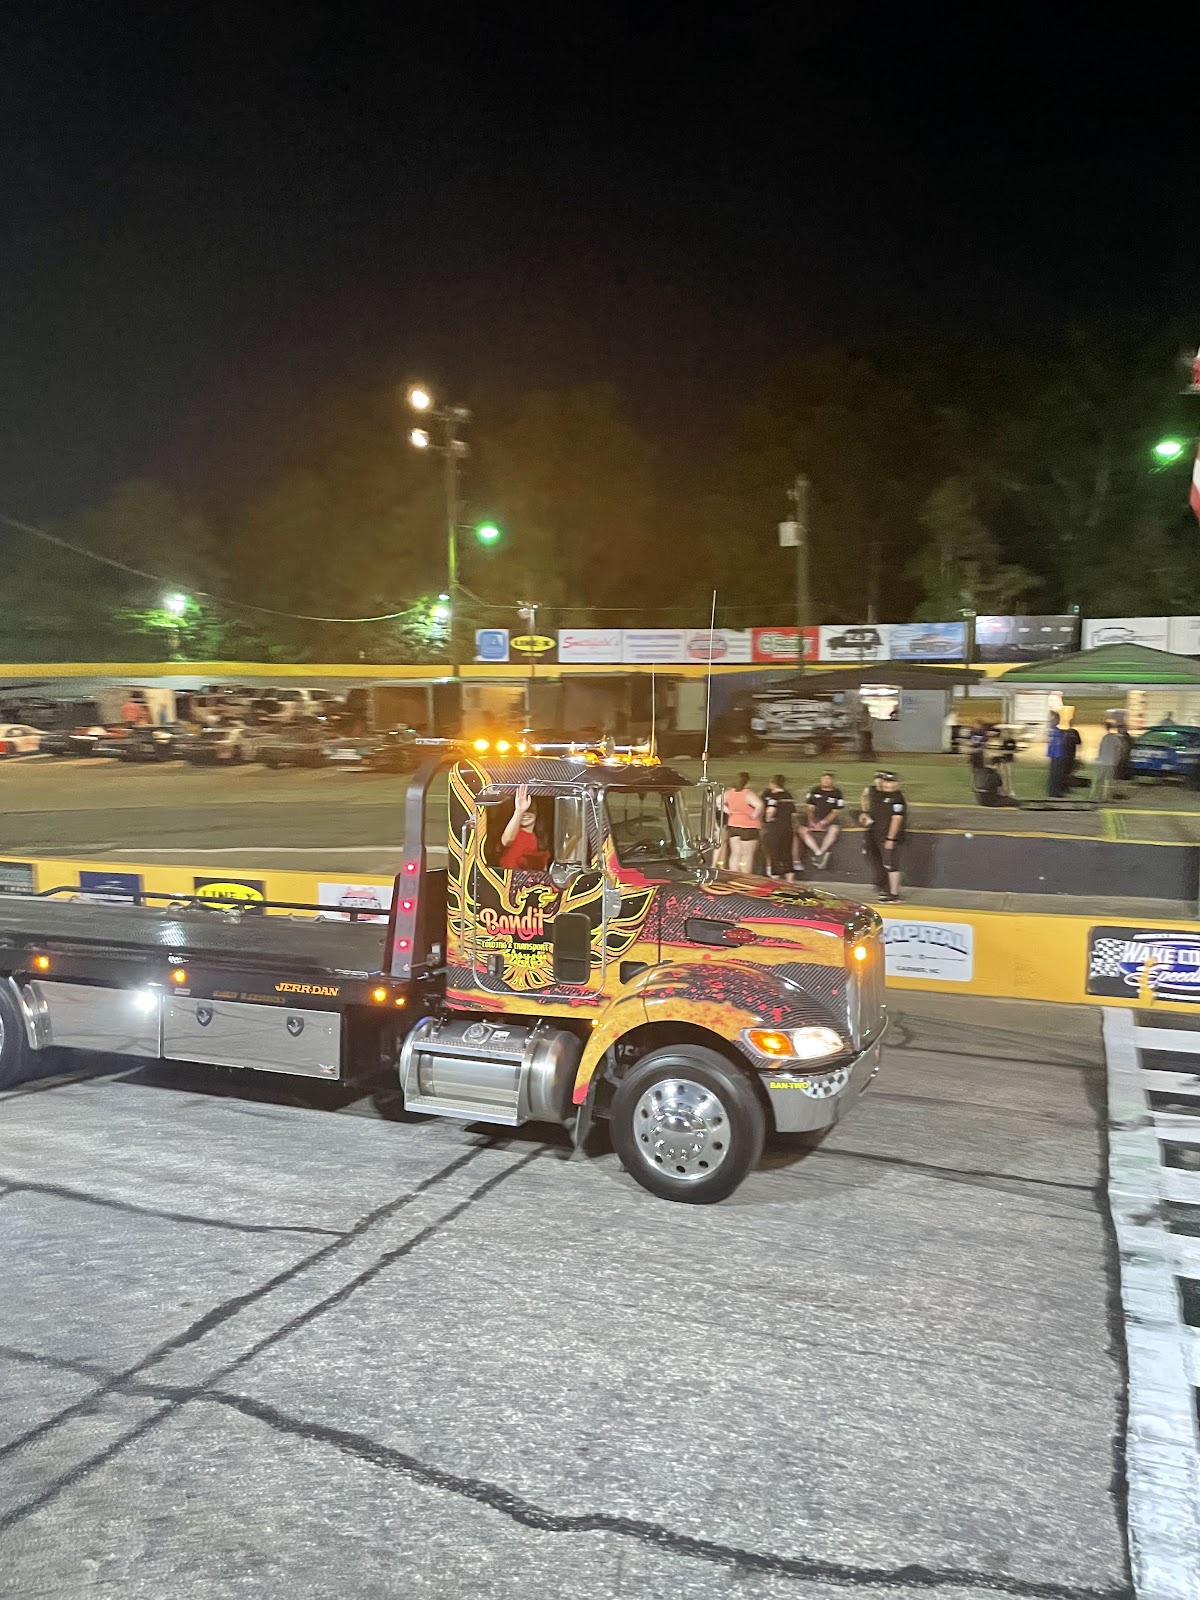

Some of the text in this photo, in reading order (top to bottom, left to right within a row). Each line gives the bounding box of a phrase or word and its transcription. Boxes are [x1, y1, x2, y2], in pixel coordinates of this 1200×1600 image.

[202, 889, 256, 901] LINEX
[479, 906, 545, 940] Bandit
[482, 941, 507, 949] TOWING
[1121, 942, 1174, 964] WAKE
